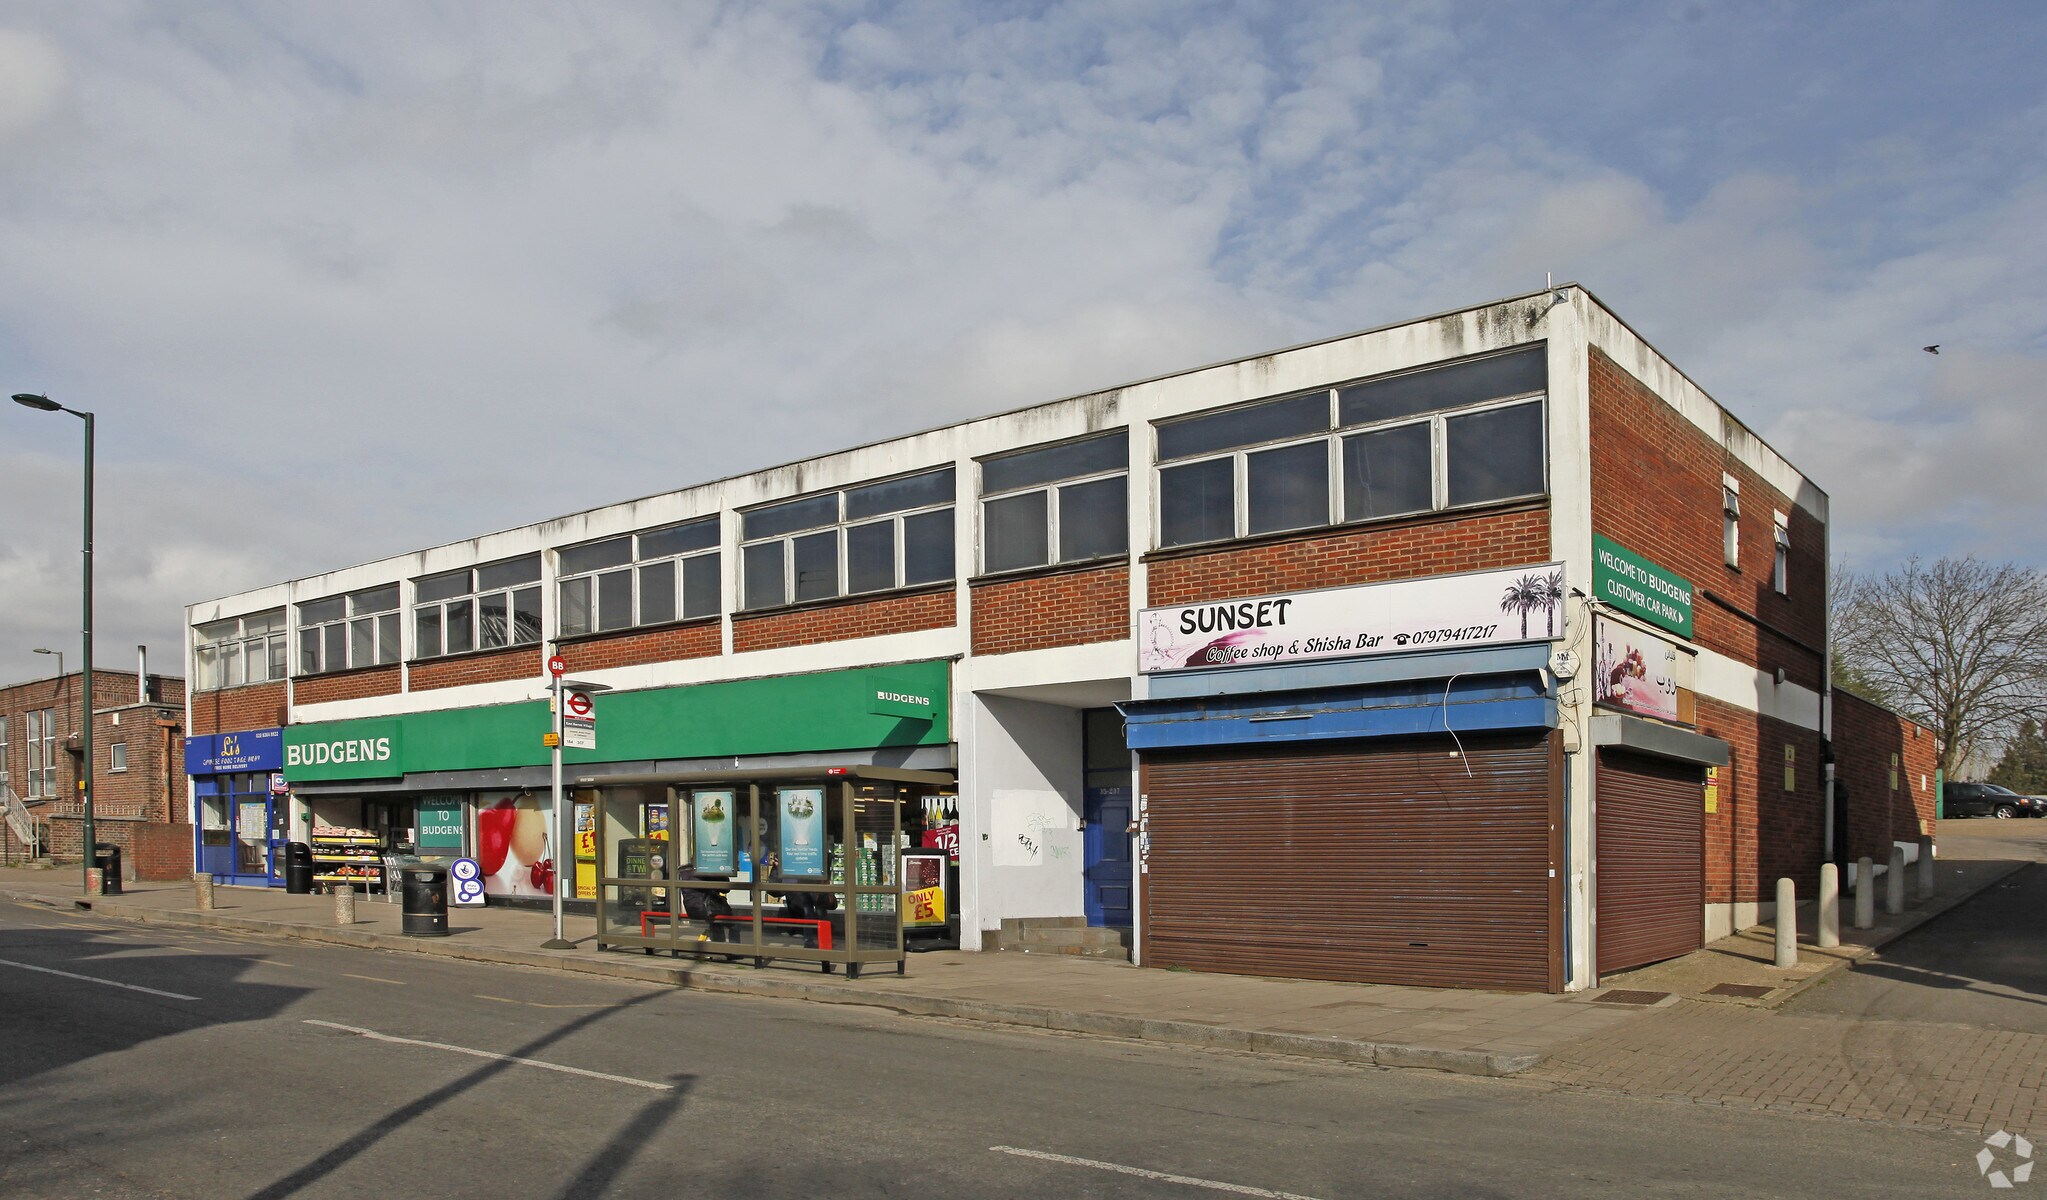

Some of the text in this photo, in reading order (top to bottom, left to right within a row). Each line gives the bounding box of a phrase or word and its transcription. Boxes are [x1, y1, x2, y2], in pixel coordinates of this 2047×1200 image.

[1599, 548, 1691, 606] WELCOME TO BUDGENS
[1607, 579, 1678, 622] CUSTOMER CAR PARK
[1180, 599, 1292, 635] SUNSET
[1206, 624, 1498, 663] Coffee shop & Shisha Bar 07979417217
[552, 661, 564, 670] BB
[877, 691, 930, 705] BUDGENS
[221, 735, 240, 757] Li's
[287, 737, 391, 766] BUDGENS
[422, 794, 463, 806] WELCOM
[437, 810, 450, 821] TO
[626, 857, 646, 865] DINNE
[633, 865, 646, 873] TW
[908, 891, 935, 905] ONLY
[914, 901, 934, 921] £5
